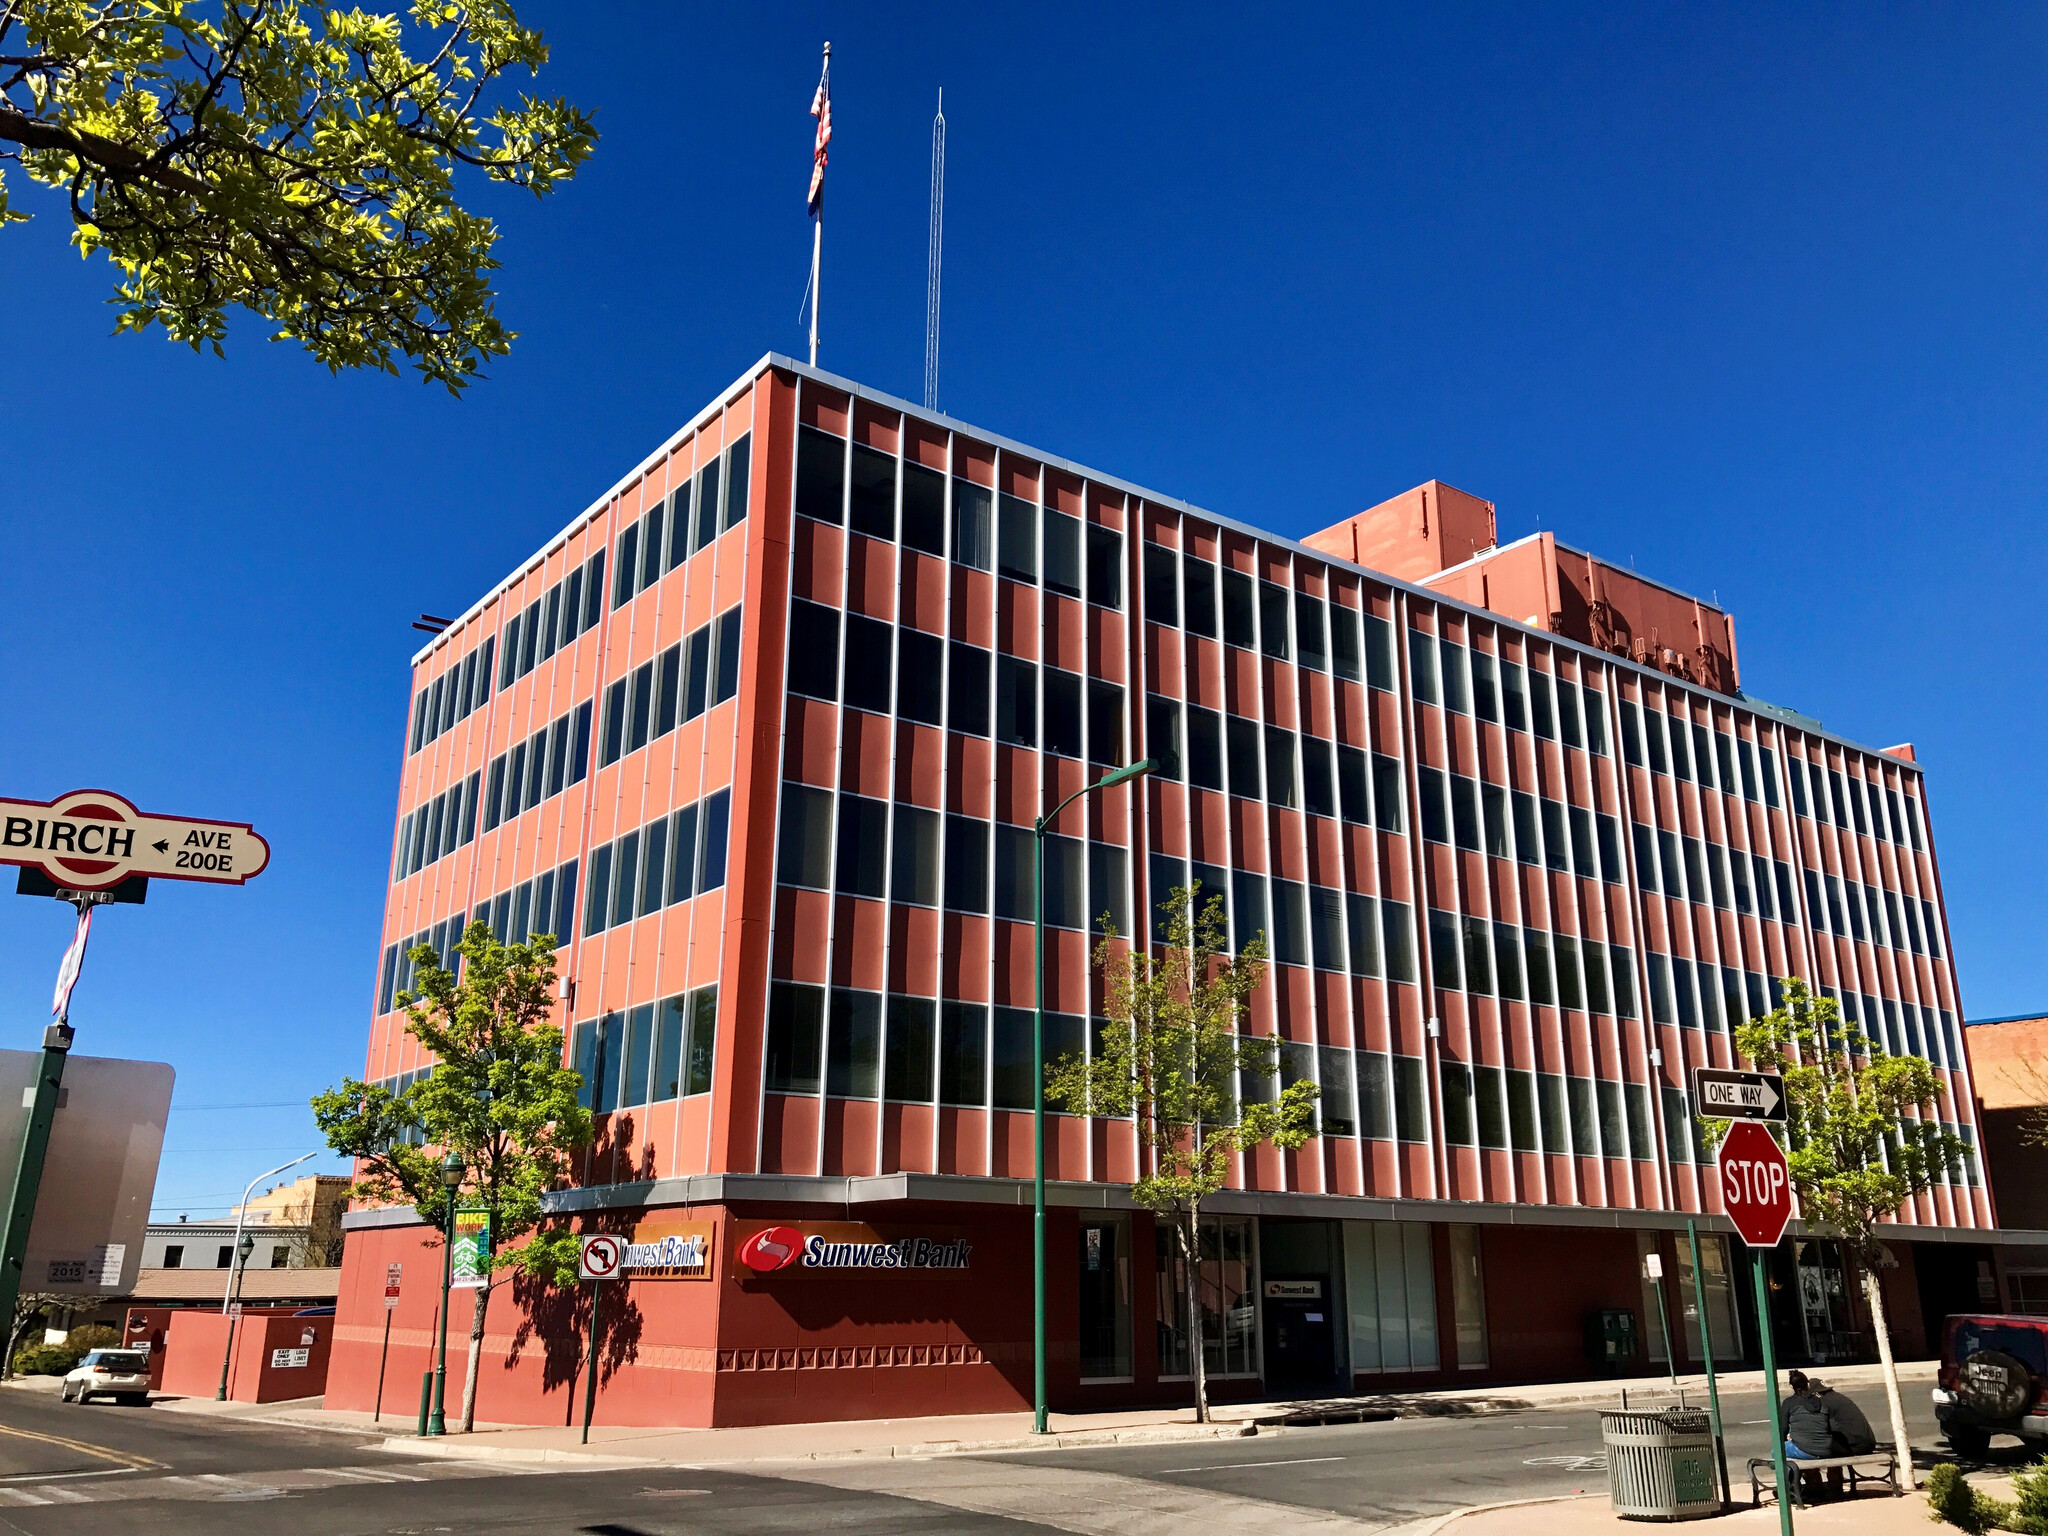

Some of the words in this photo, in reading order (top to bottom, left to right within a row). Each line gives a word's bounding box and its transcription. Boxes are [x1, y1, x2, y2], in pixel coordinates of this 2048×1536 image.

[2, 816, 136, 858] BIRCH
[183, 829, 232, 850] AVE
[175, 850, 233, 872] 200E
[1709, 1084, 1735, 1103] ONE
[1740, 1086, 1763, 1105] WAY
[1726, 1159, 1784, 1205] STOP
[456, 1213, 488, 1224] BIKE
[456, 1223, 483, 1231] WORK
[478, 1229, 489, 1256] WEEK
[663, 1235, 702, 1268] Bank
[803, 1235, 911, 1268] Sunwest
[912, 1237, 972, 1269] Bank
[52, 1267, 81, 1277] 2015
[1280, 1286, 1302, 1294] Sunwest
[1302, 1286, 1315, 1294] Bank
[1975, 1365, 2002, 1379] Jeep
